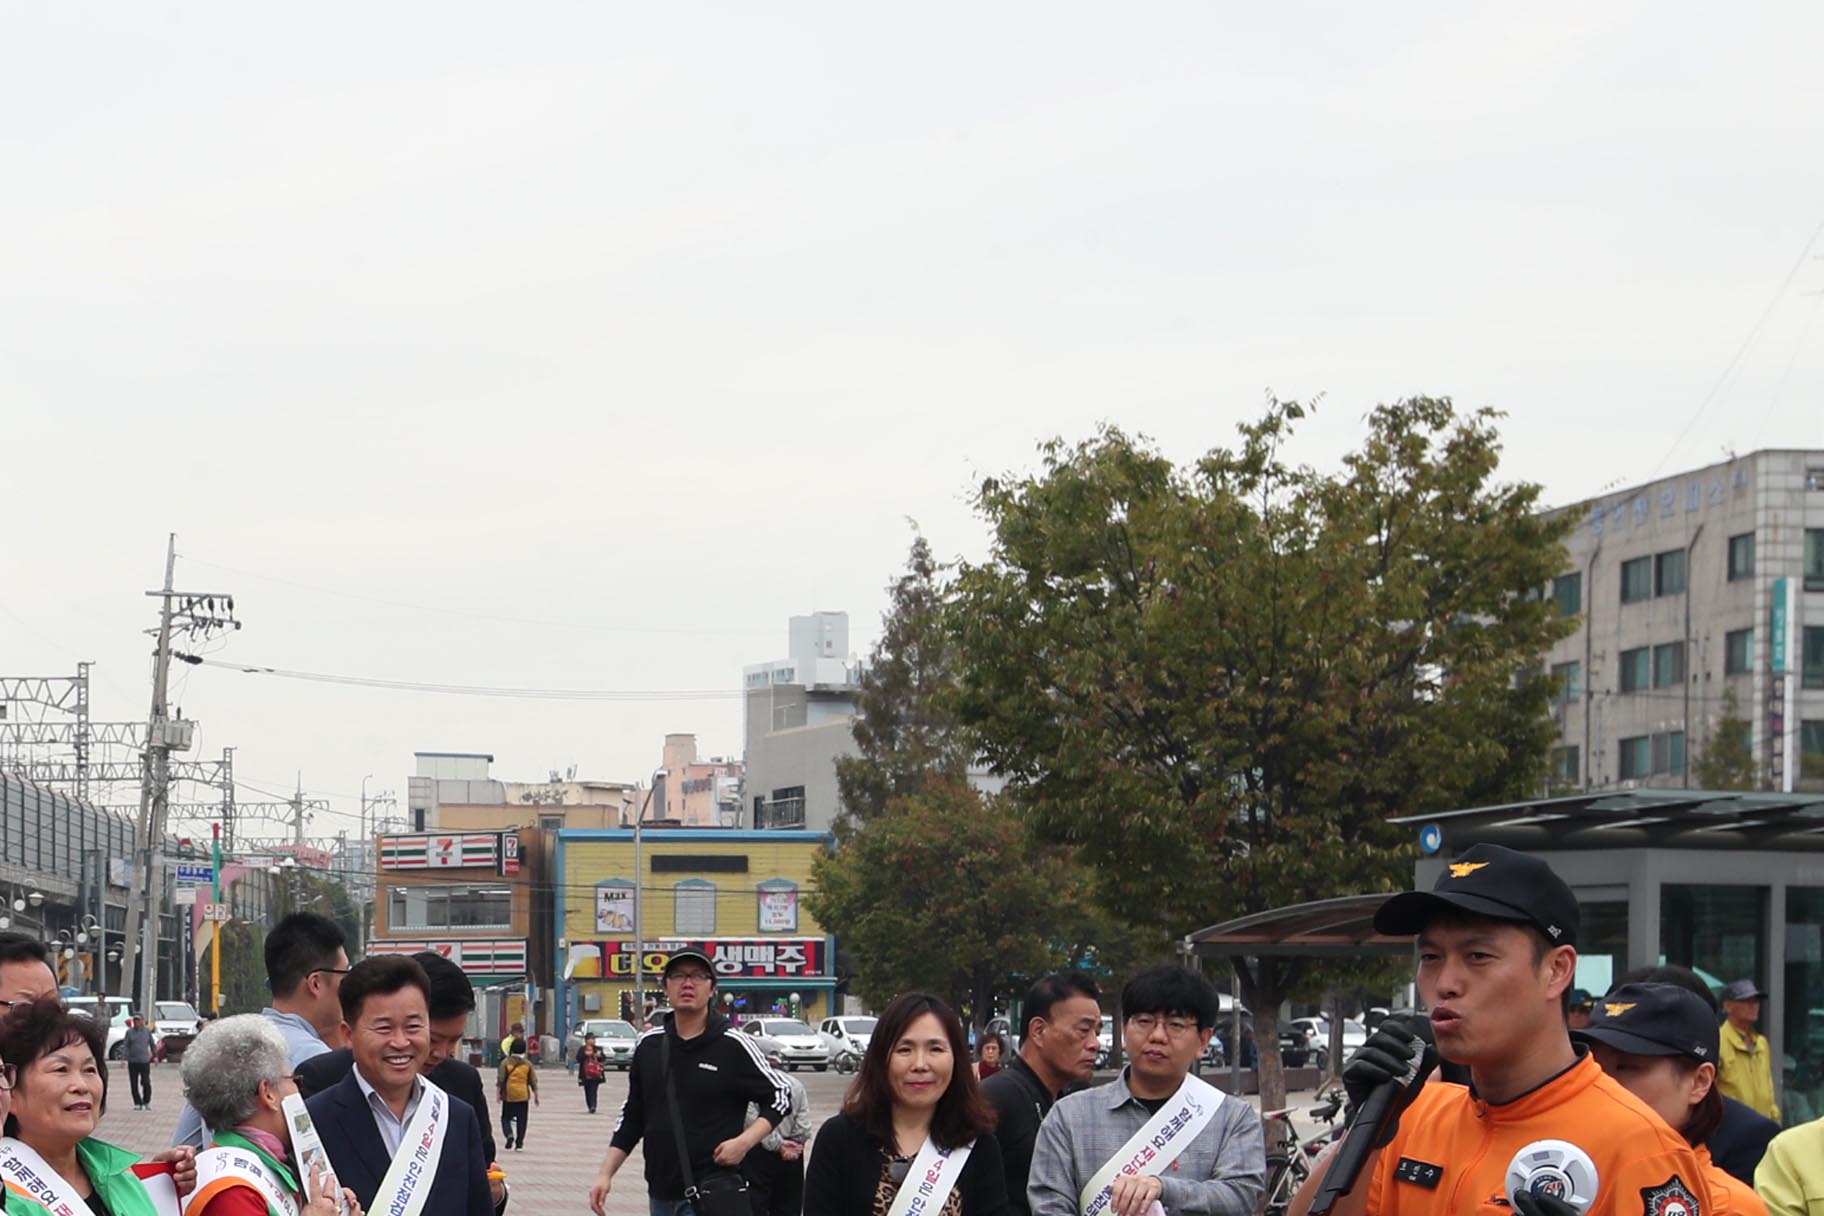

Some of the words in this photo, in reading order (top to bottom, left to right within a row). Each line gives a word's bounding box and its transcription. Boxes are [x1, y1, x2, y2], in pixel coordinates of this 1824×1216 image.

[604, 892, 627, 903] Max
[711, 944, 808, 974] 생맥주
[1151, 1106, 1193, 1151] 함께해요
[2, 1156, 60, 1206] 함께해요
[918, 1159, 945, 1198] 4일은
